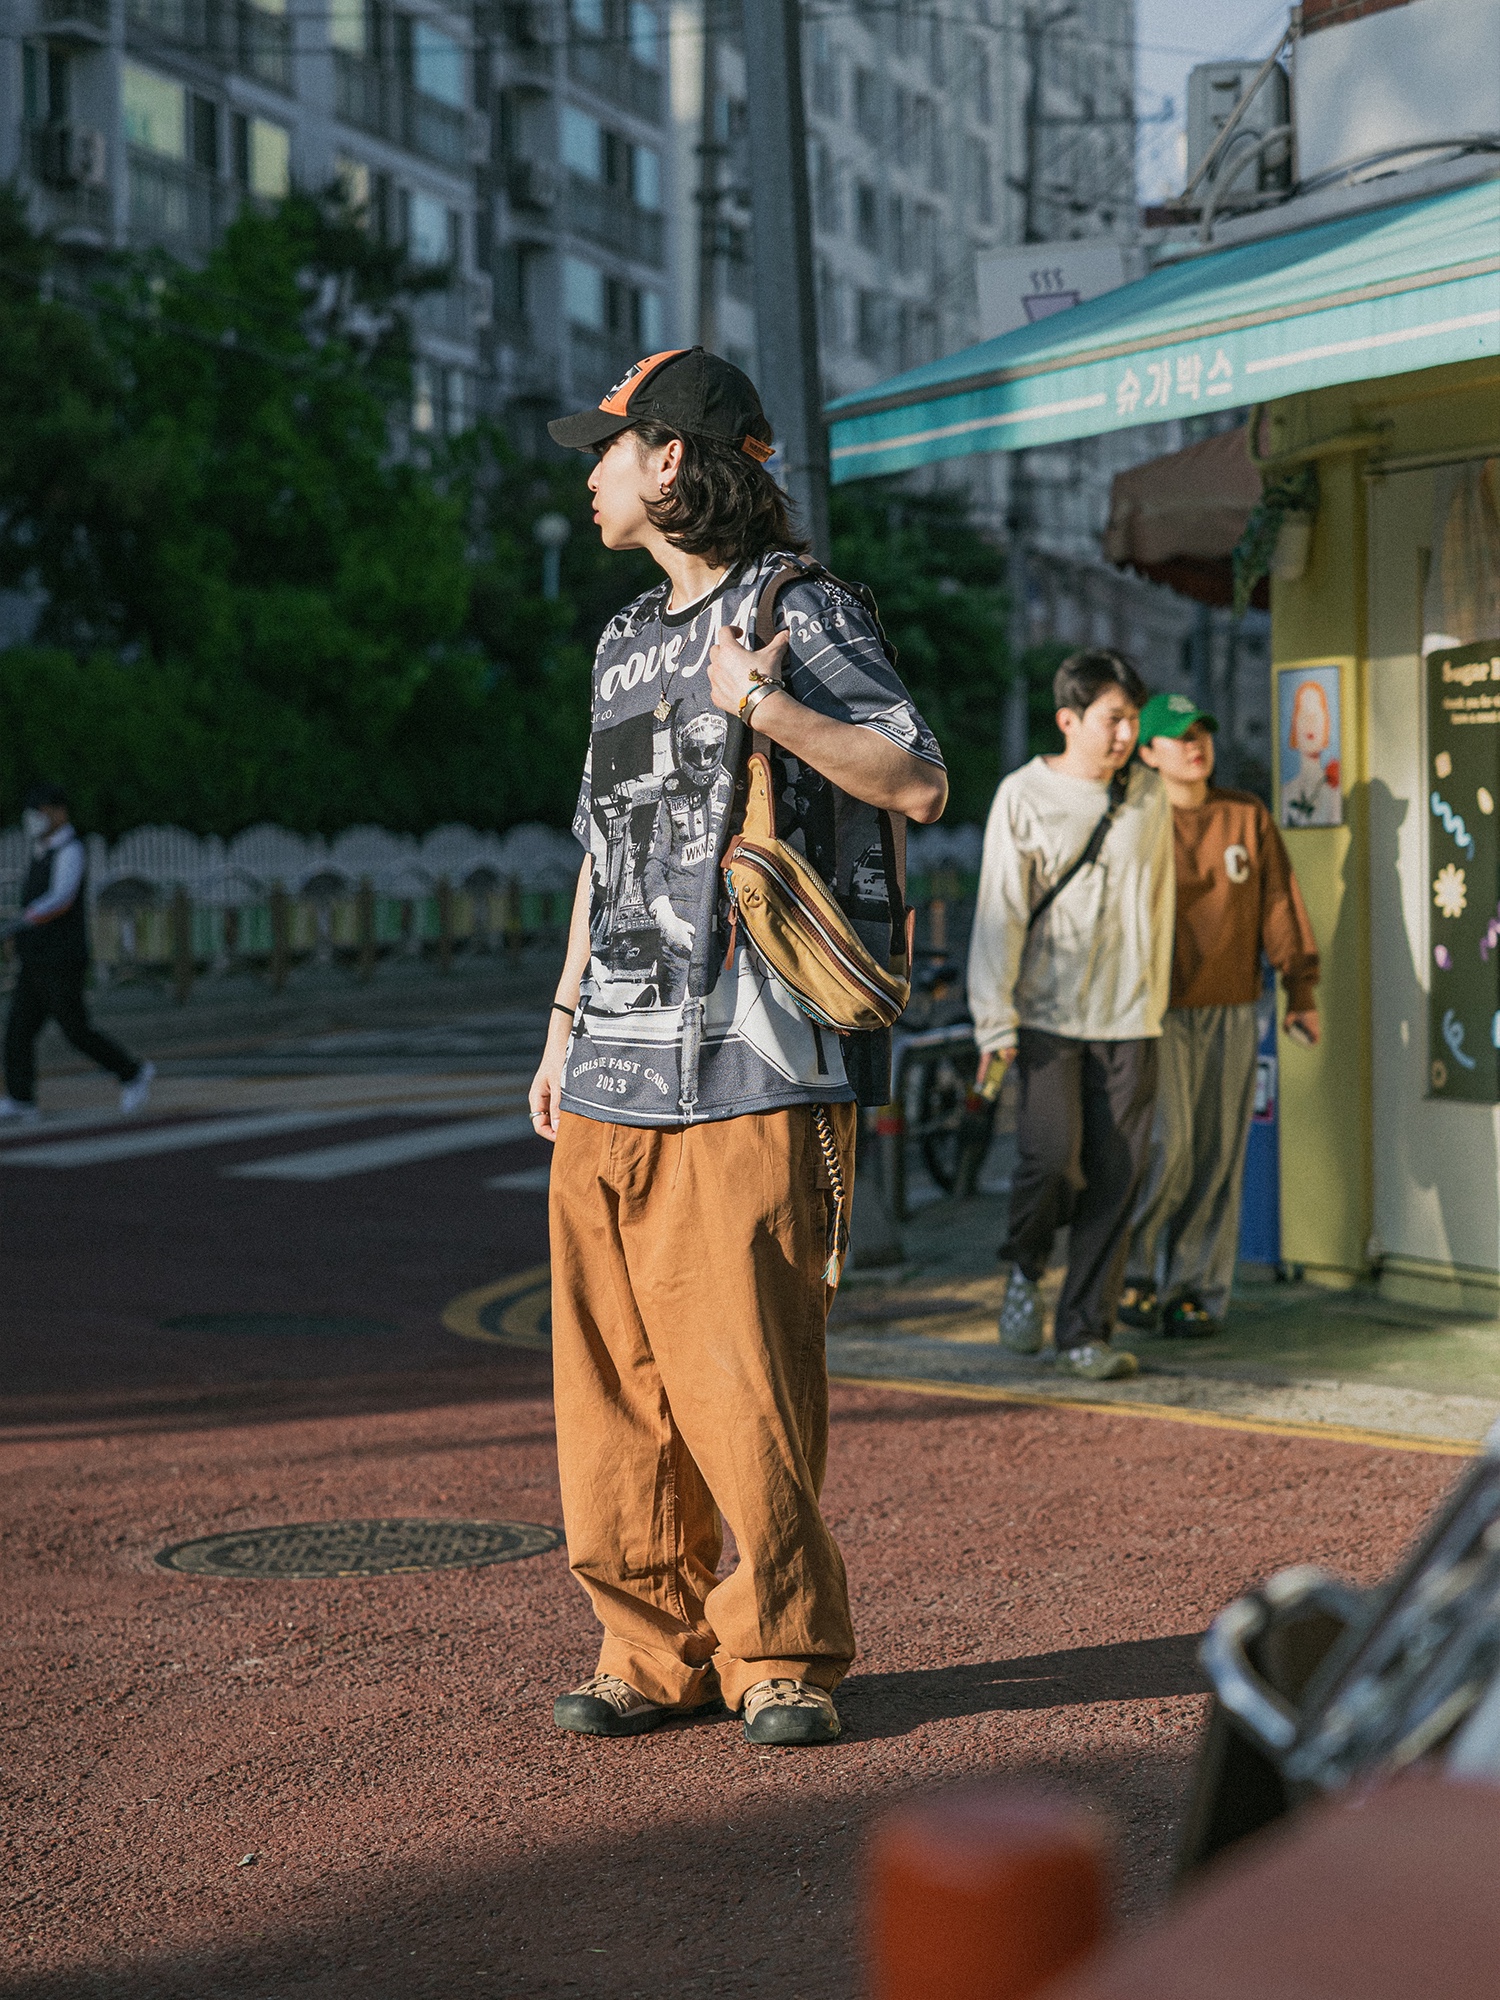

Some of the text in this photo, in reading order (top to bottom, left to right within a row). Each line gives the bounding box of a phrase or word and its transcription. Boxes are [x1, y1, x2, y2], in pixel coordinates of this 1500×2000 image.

[1116, 349, 1233, 416] 슈가박스
[797, 612, 846, 643] 2023
[572, 815, 587, 835] 23
[1223, 843, 1251, 884] C
[572, 1059, 598, 1078] GIRLS
[608, 1058, 641, 1075] FAST
[643, 1067, 670, 1095] CARS
[596, 1074, 627, 1094] 2023
